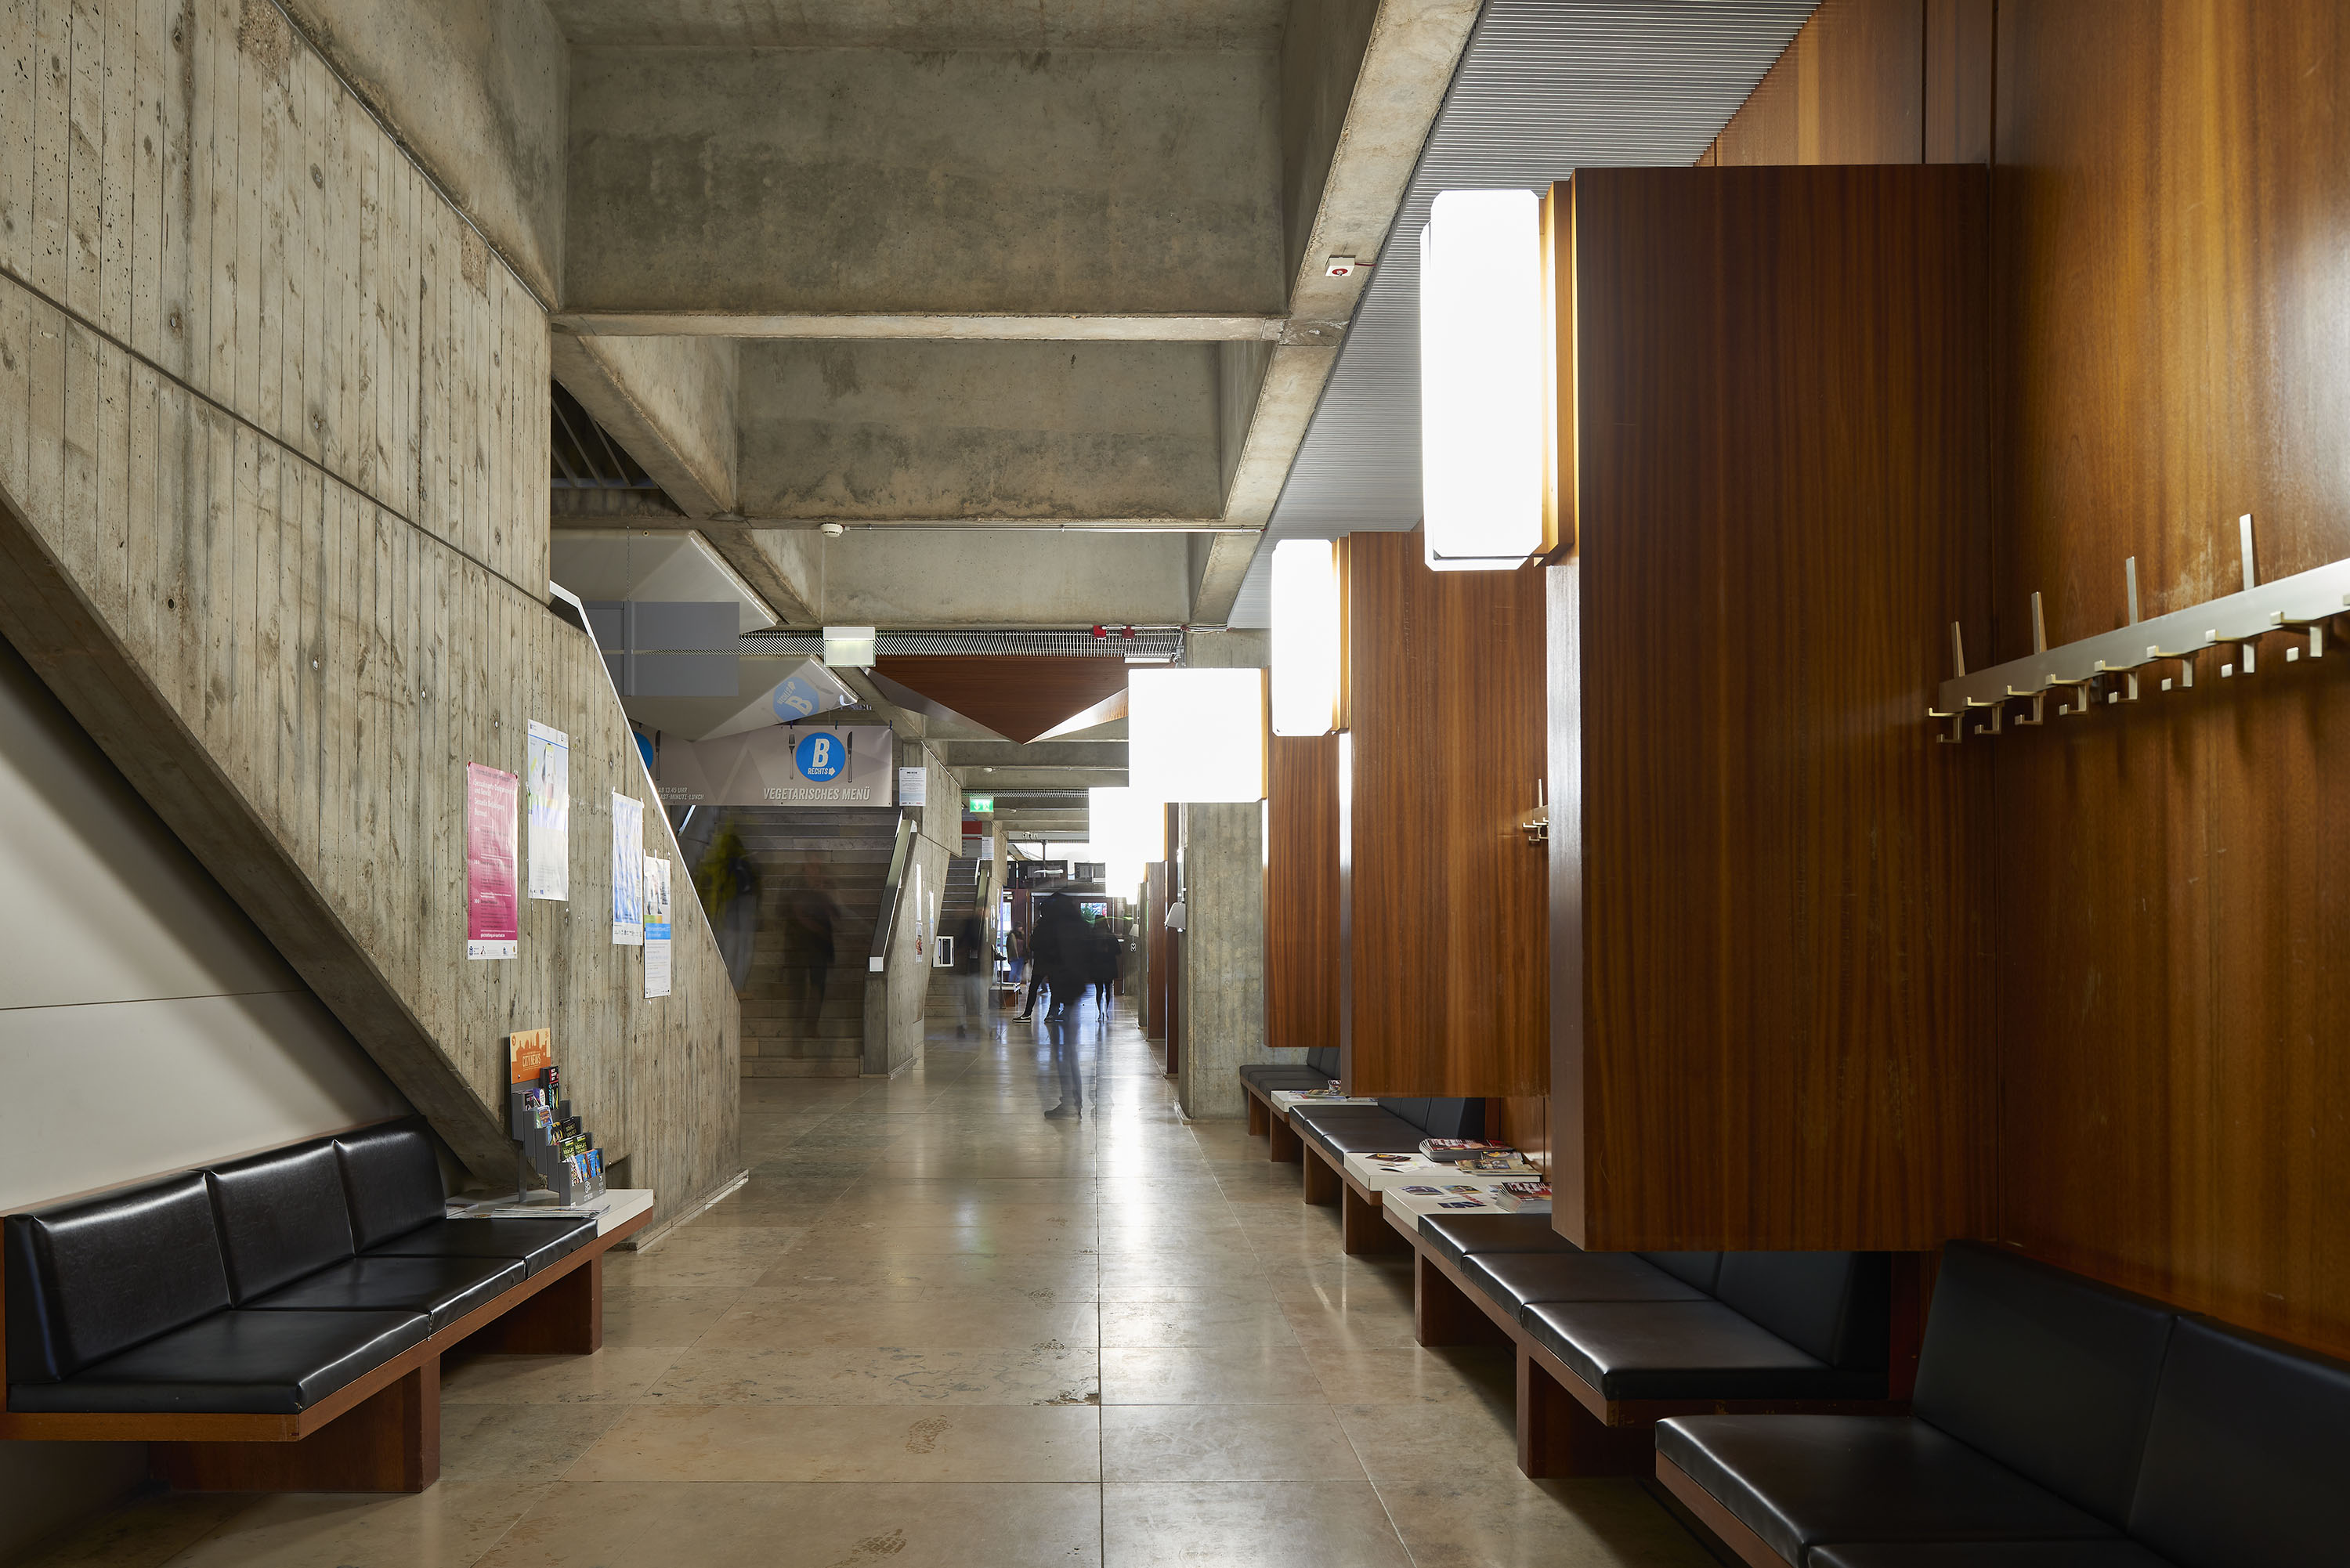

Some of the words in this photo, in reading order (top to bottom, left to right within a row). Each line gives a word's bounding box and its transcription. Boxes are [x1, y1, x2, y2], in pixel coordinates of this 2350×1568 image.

[812, 738, 830, 768] B
[764, 788, 840, 800] VEGETARISCHES
[842, 786, 871, 800] MENÜ
